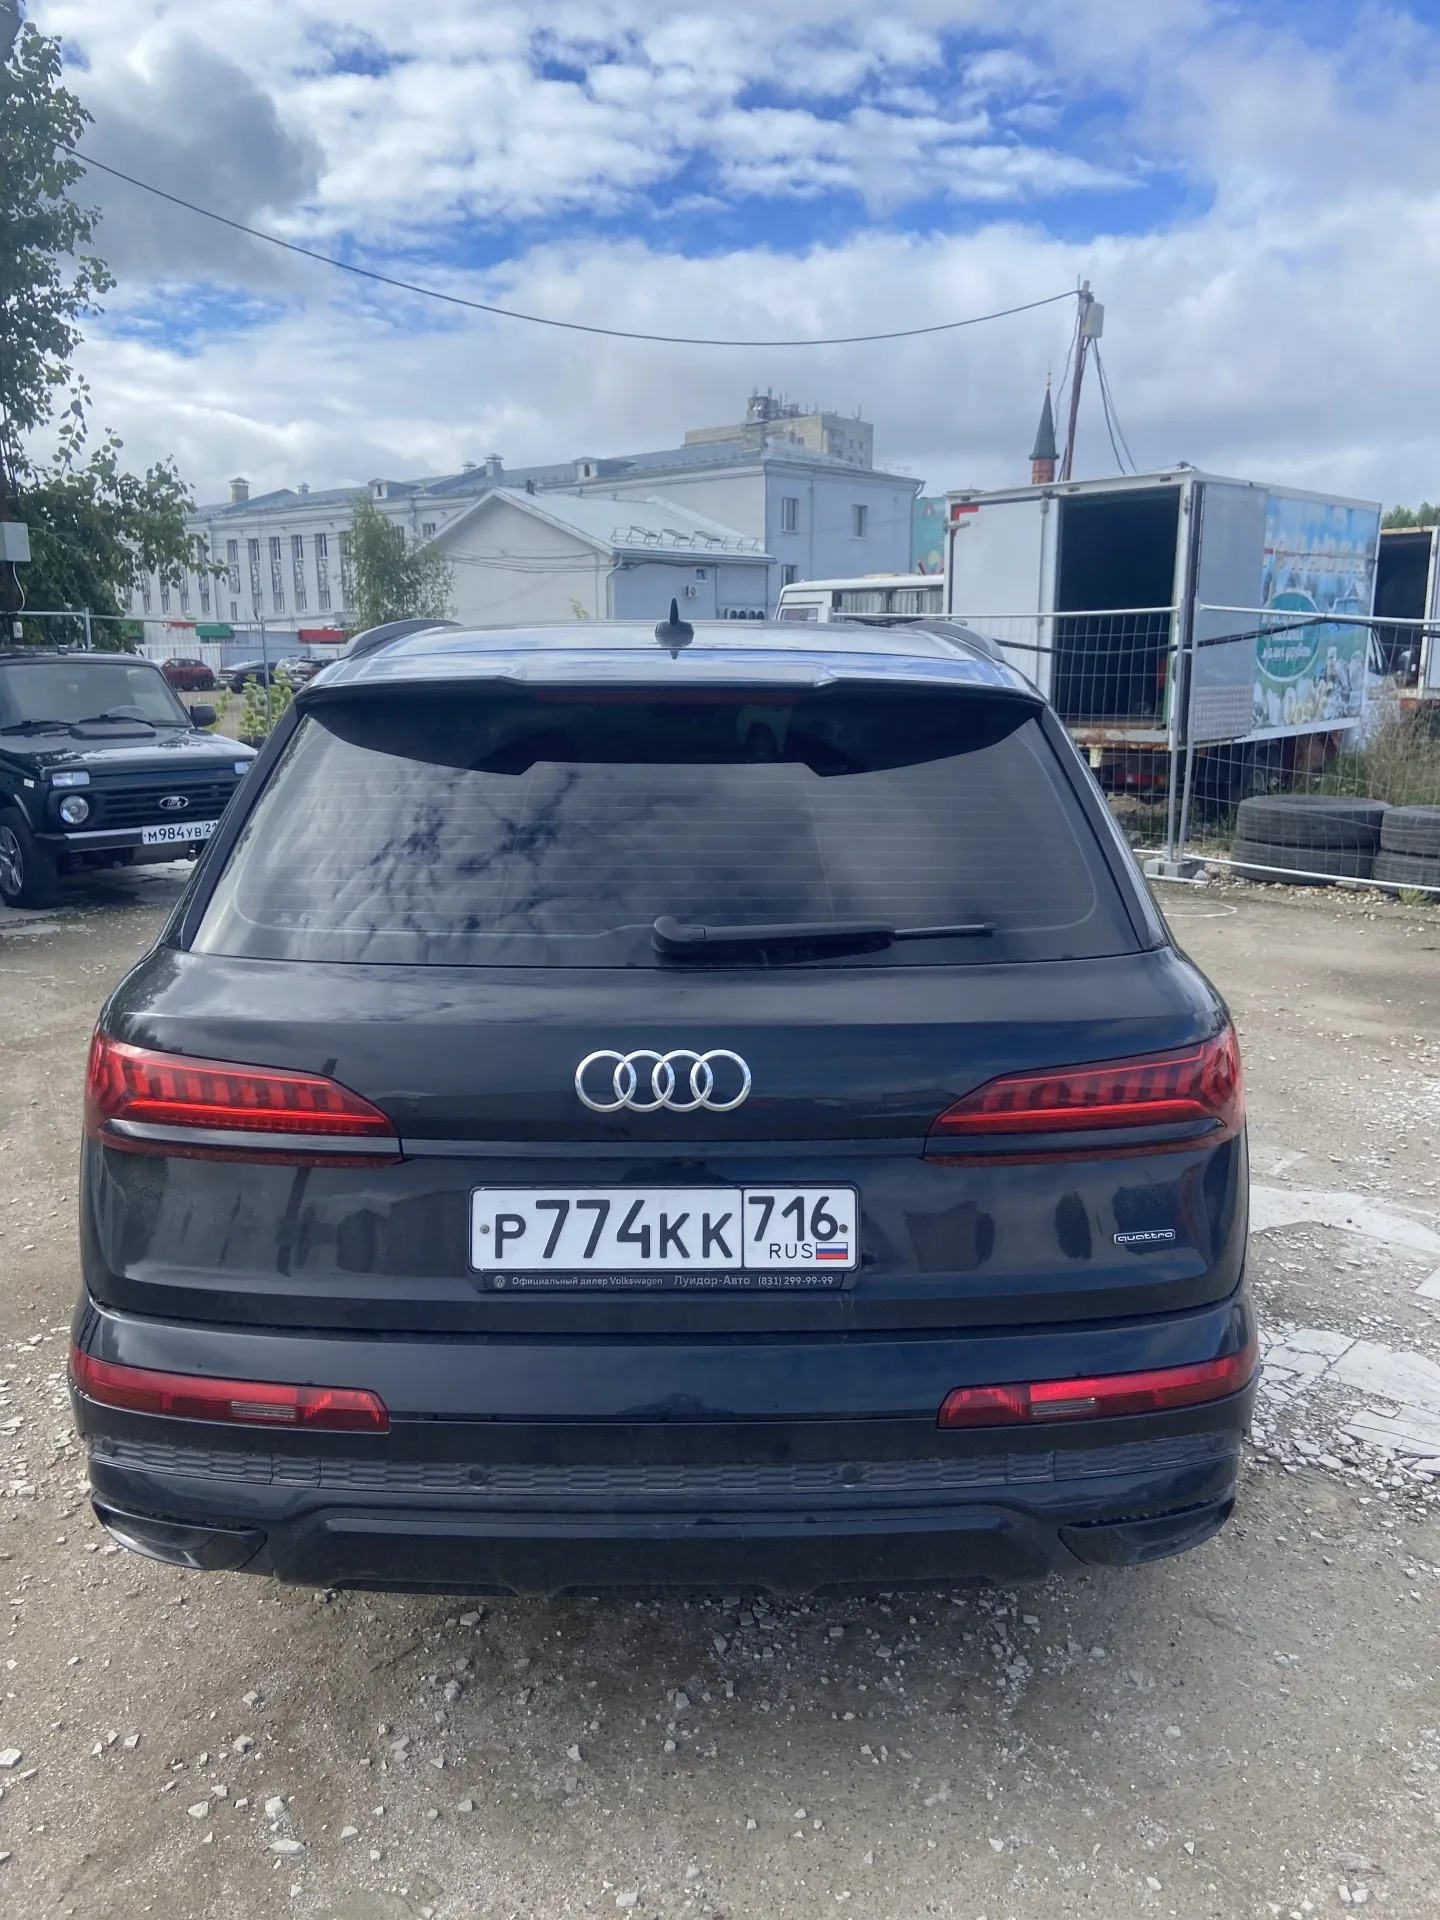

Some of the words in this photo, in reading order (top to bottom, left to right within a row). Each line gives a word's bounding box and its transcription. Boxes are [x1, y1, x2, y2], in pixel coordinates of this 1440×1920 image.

[148, 826, 202, 842] М984УВ
[494, 1199, 733, 1259] Р774КК
[748, 1195, 838, 1242] 716
[1117, 1232, 1173, 1243] quattro
[769, 1243, 813, 1259] RUS
[512, 1276, 578, 1286] Официальный
[580, 1277, 608, 1287] дилер
[609, 1276, 663, 1287] Volkswagen
[673, 1275, 751, 1287] Луидор-Авто
[758, 1276, 782, 1287] (831)
[784, 1276, 834, 1286] 299-99-99
